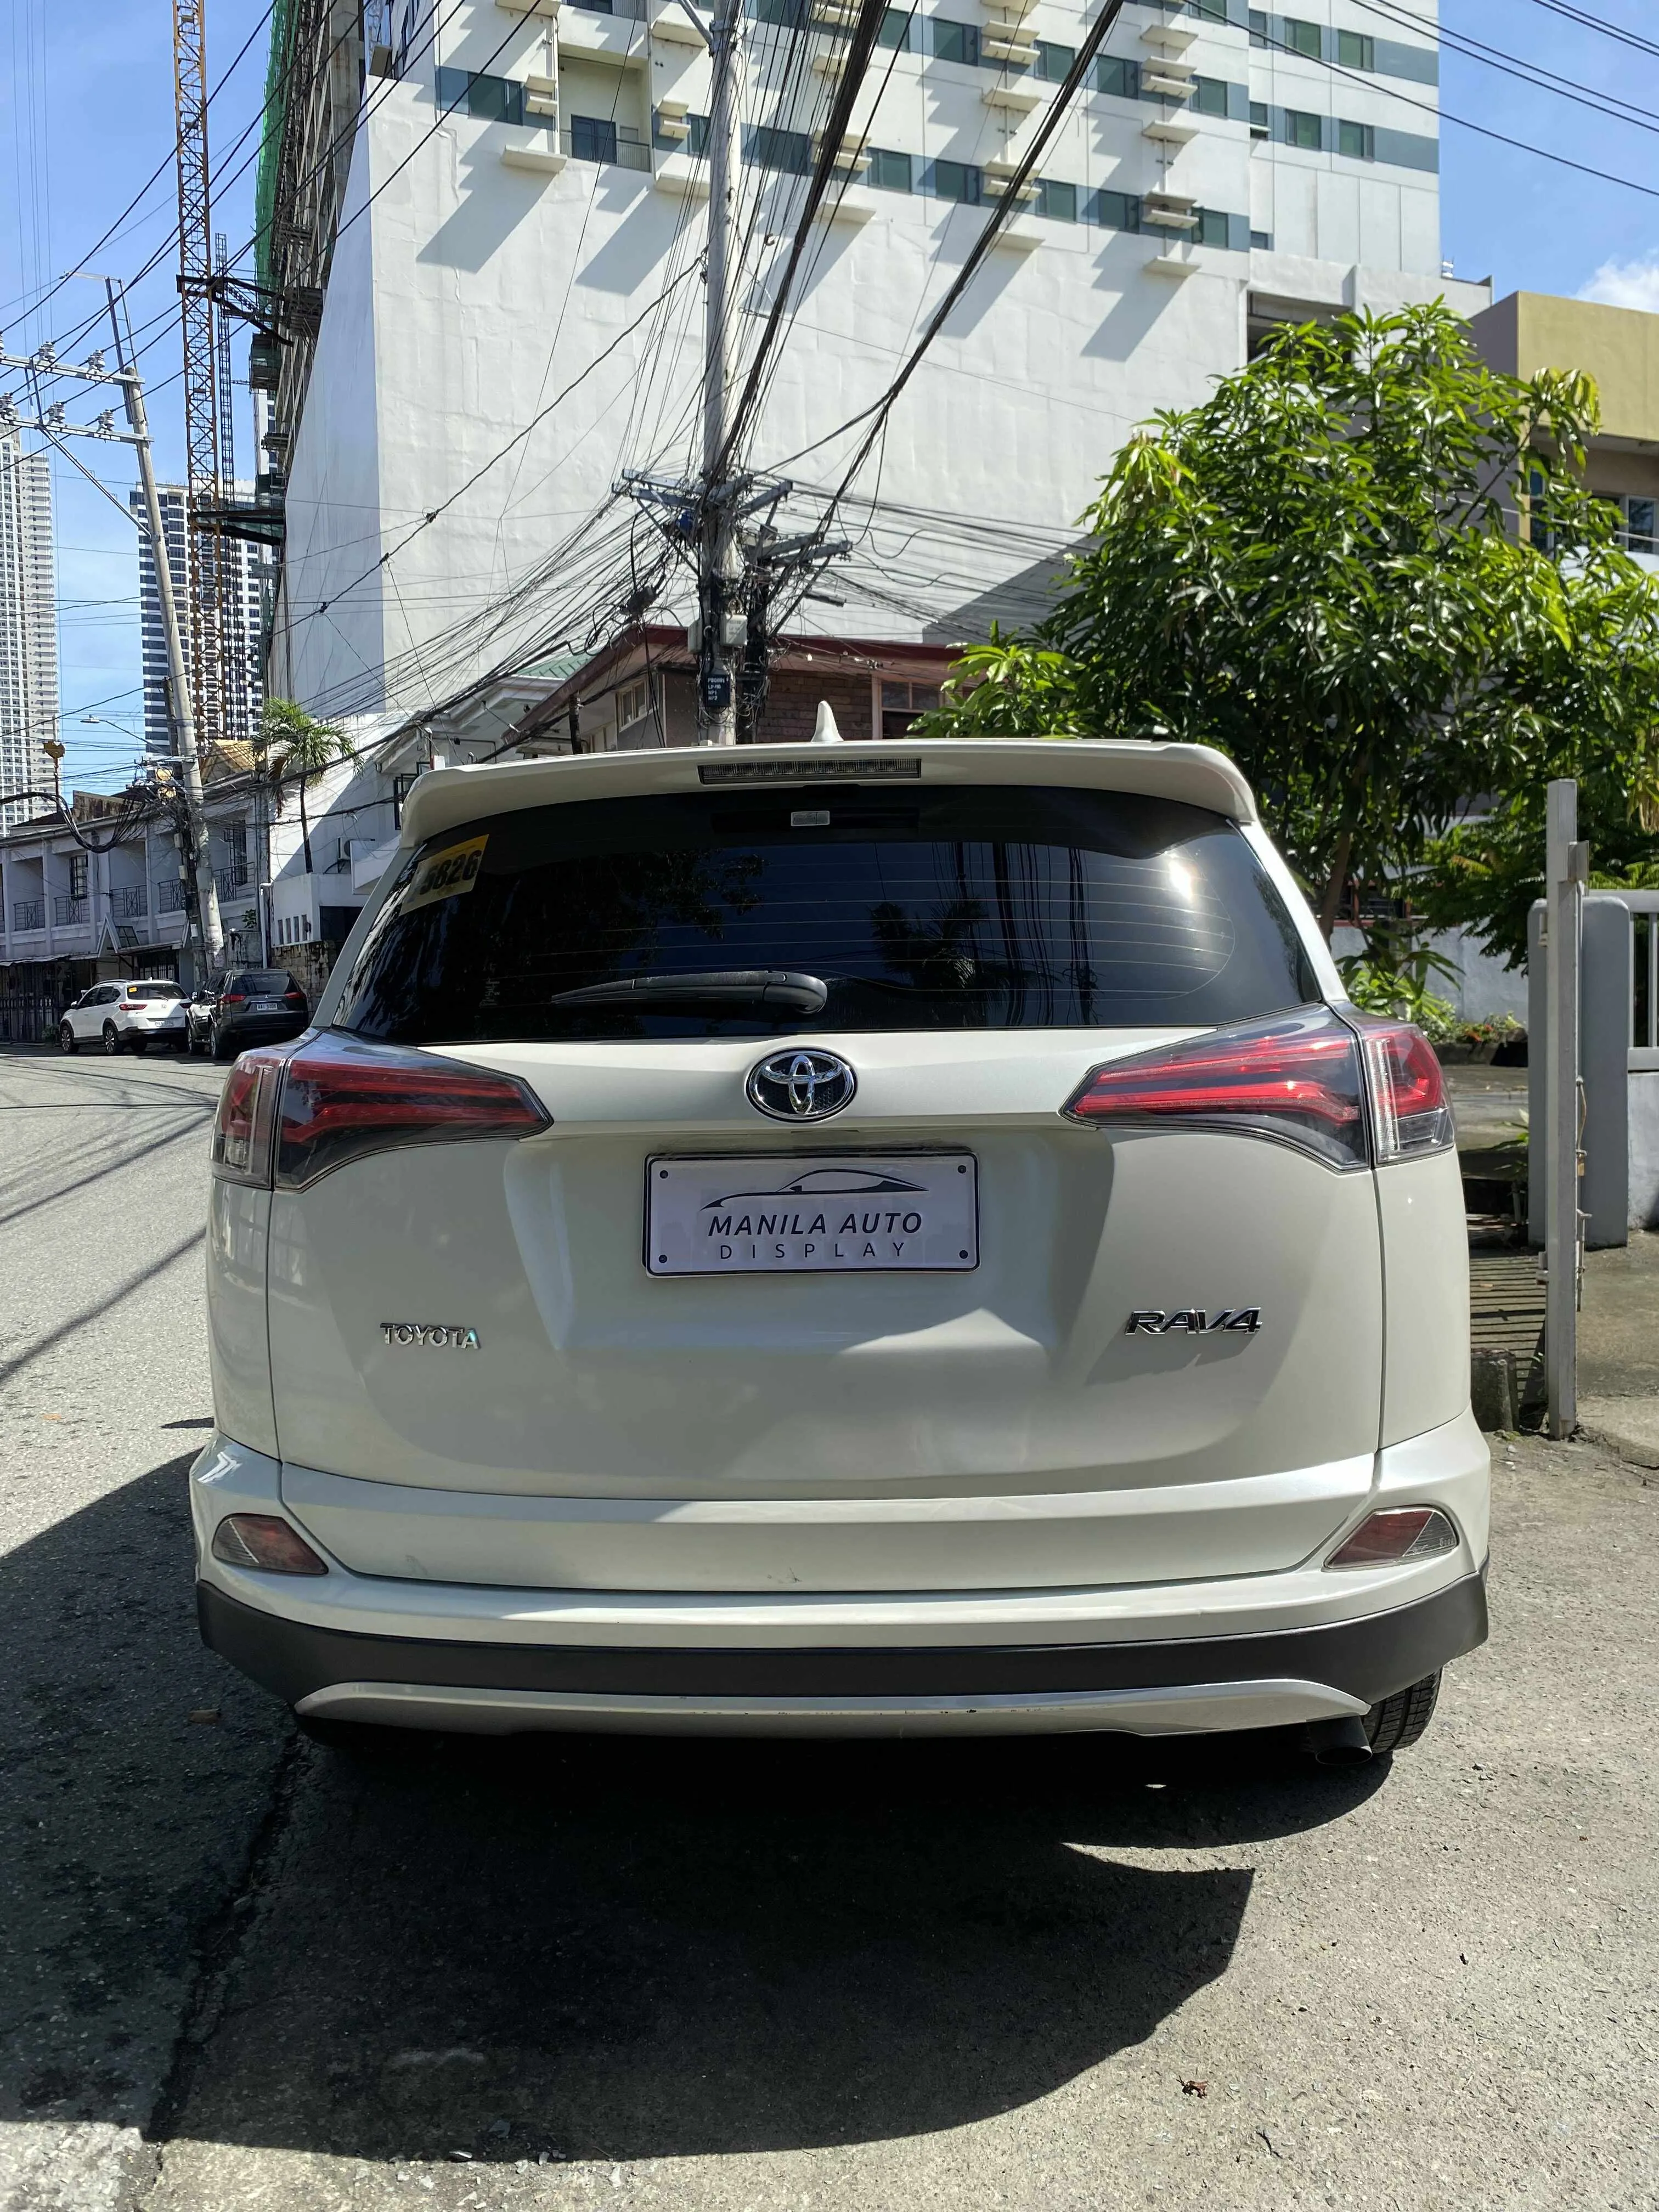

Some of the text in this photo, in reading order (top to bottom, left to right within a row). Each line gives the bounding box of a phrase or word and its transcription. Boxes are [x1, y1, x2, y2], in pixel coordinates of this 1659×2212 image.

[708, 1212, 922, 1237] MANILA AUTO
[720, 1242, 905, 1260] DISPLAY
[1125, 1306, 1262, 1335] RAV4
[380, 1323, 481, 1349] TOYOTA
